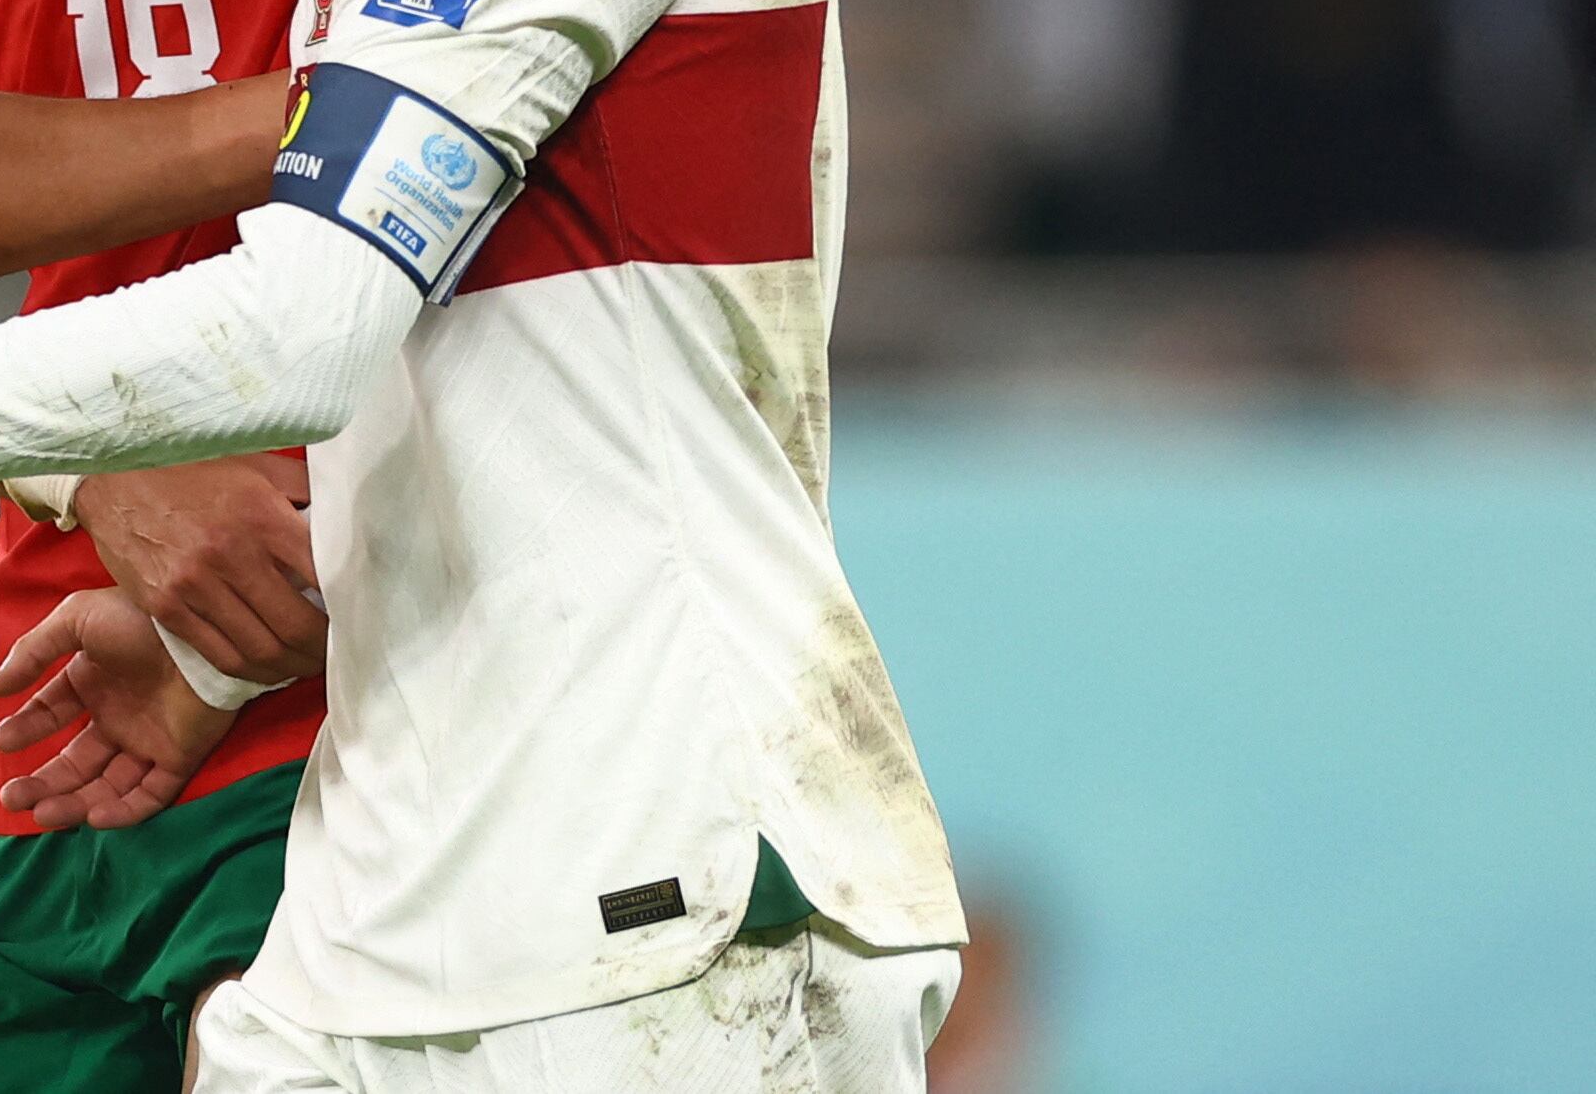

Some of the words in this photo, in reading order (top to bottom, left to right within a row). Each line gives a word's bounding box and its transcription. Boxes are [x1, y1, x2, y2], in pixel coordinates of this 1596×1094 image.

[273, 151, 324, 180] ATION
[393, 158, 432, 190] World
[385, 170, 455, 231] Organization
[387, 217, 419, 250] FIFA
